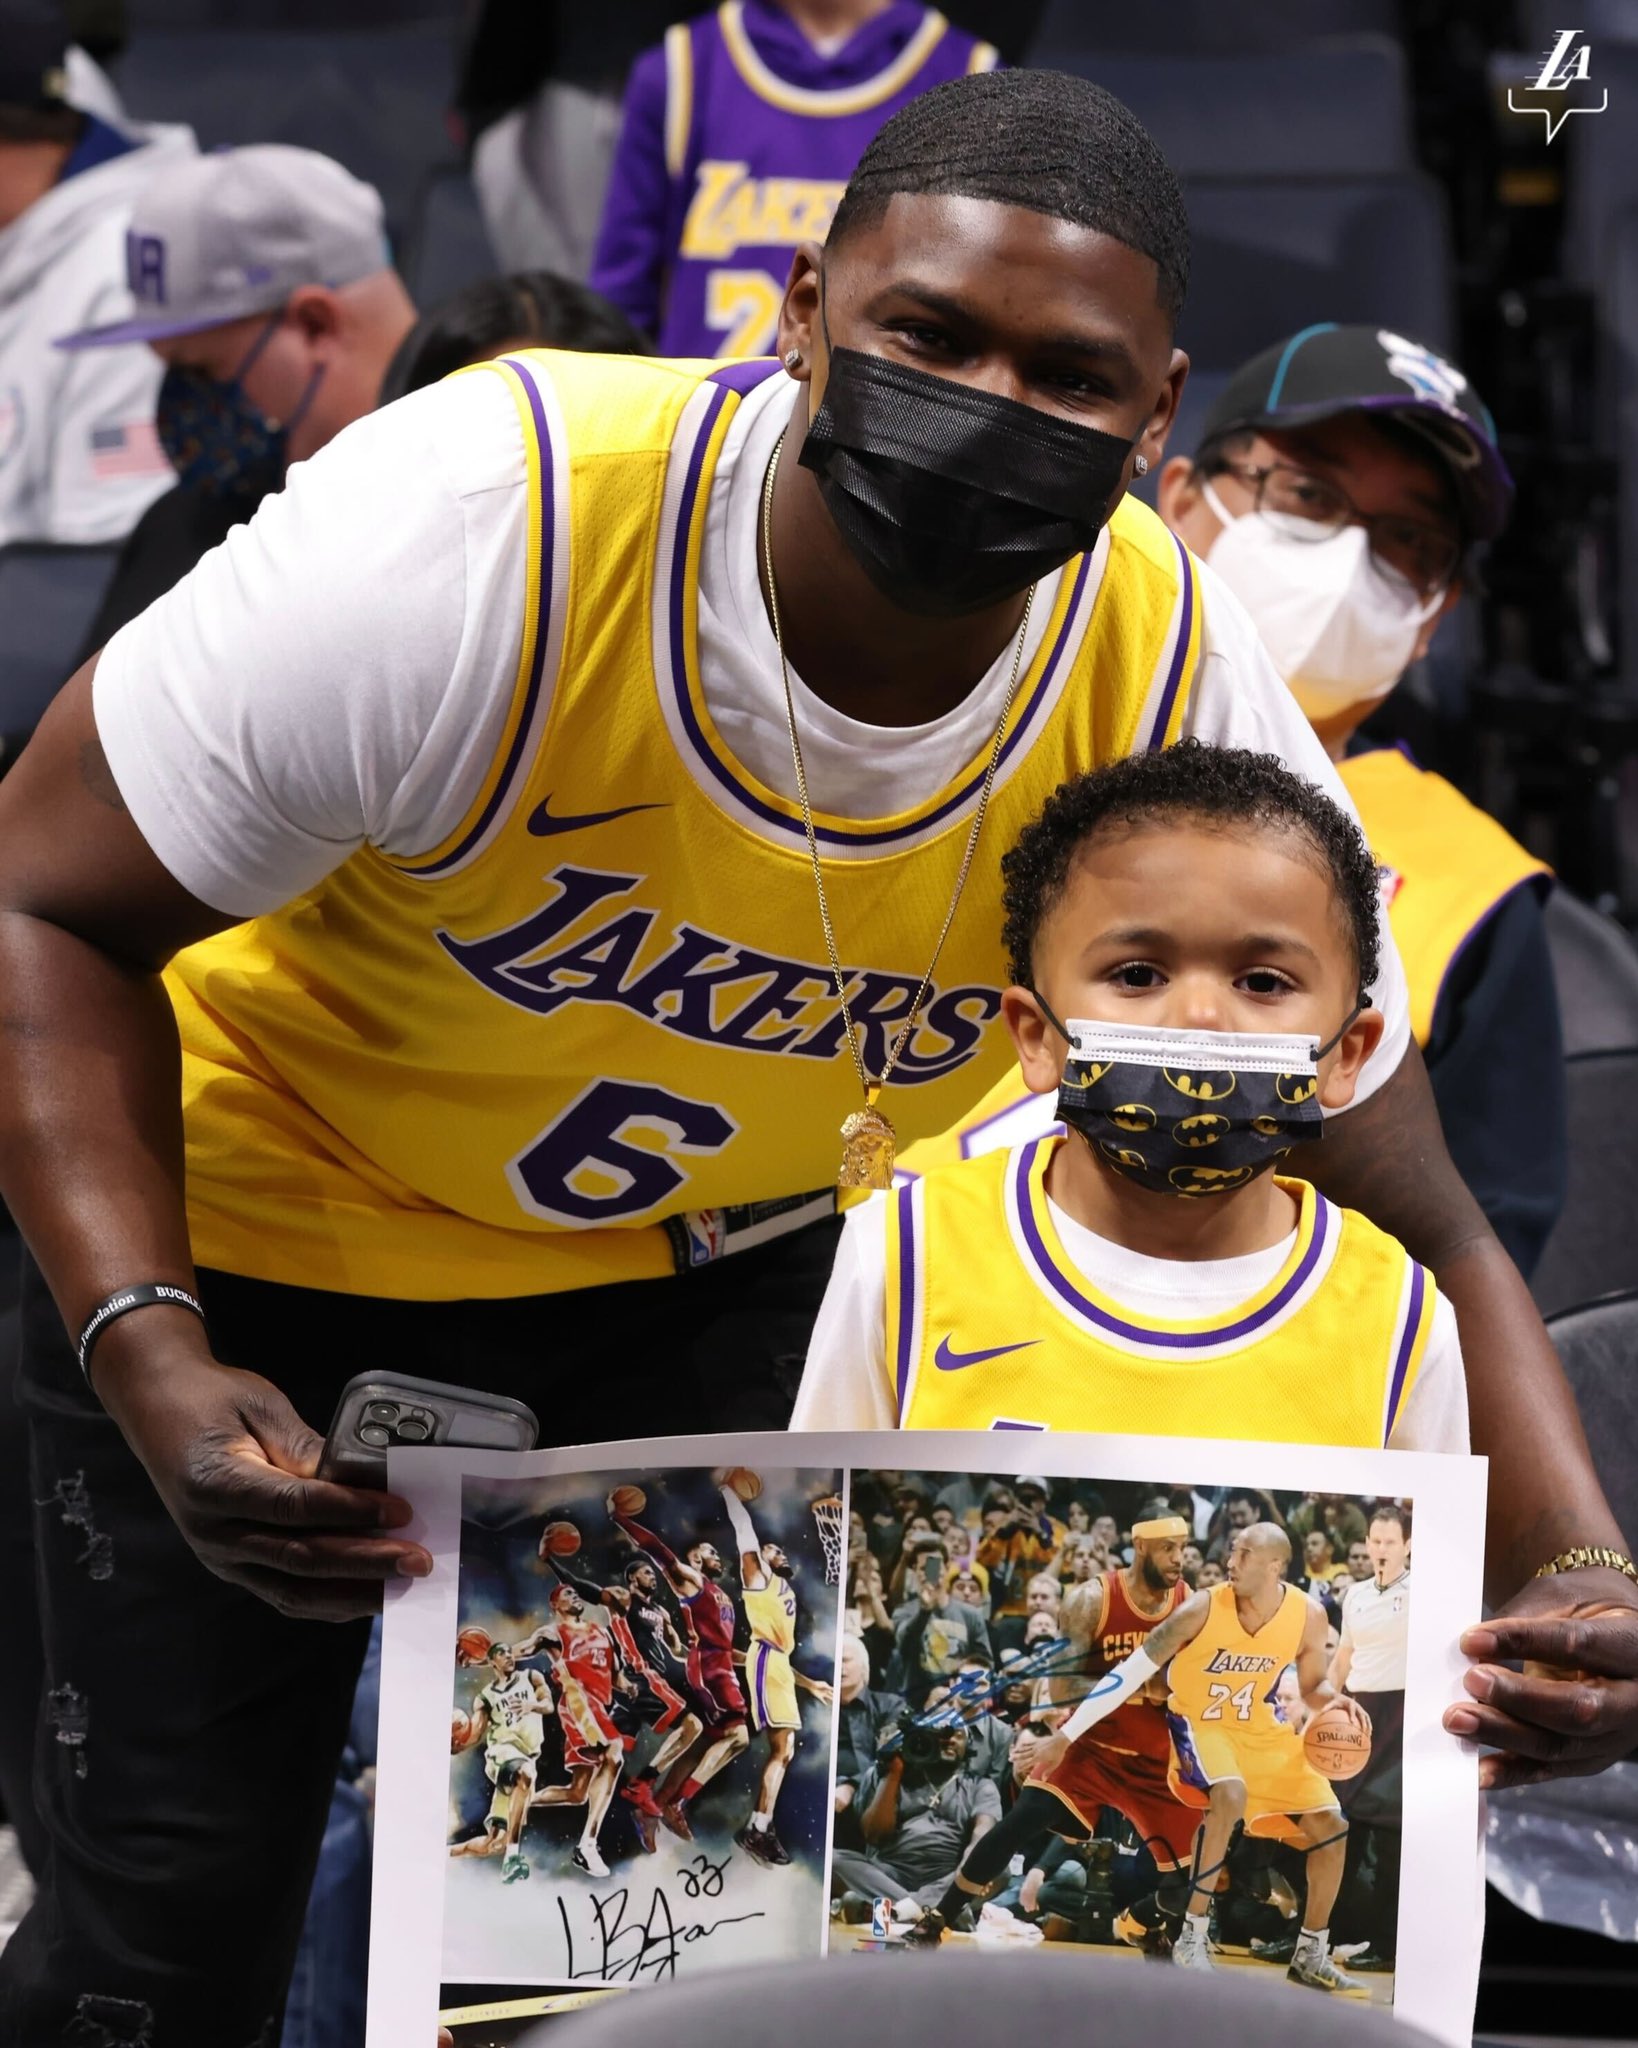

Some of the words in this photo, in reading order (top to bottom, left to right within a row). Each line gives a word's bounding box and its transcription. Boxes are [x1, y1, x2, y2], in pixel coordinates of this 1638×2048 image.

[680, 160, 848, 260] LAKE
[434, 862, 1004, 1087] LAKERS
[505, 1075, 741, 1228] 6
[1103, 1631, 1150, 1662] CLEV
[1204, 1648, 1280, 1674] LAKERS
[1201, 1681, 1258, 1721] 24
